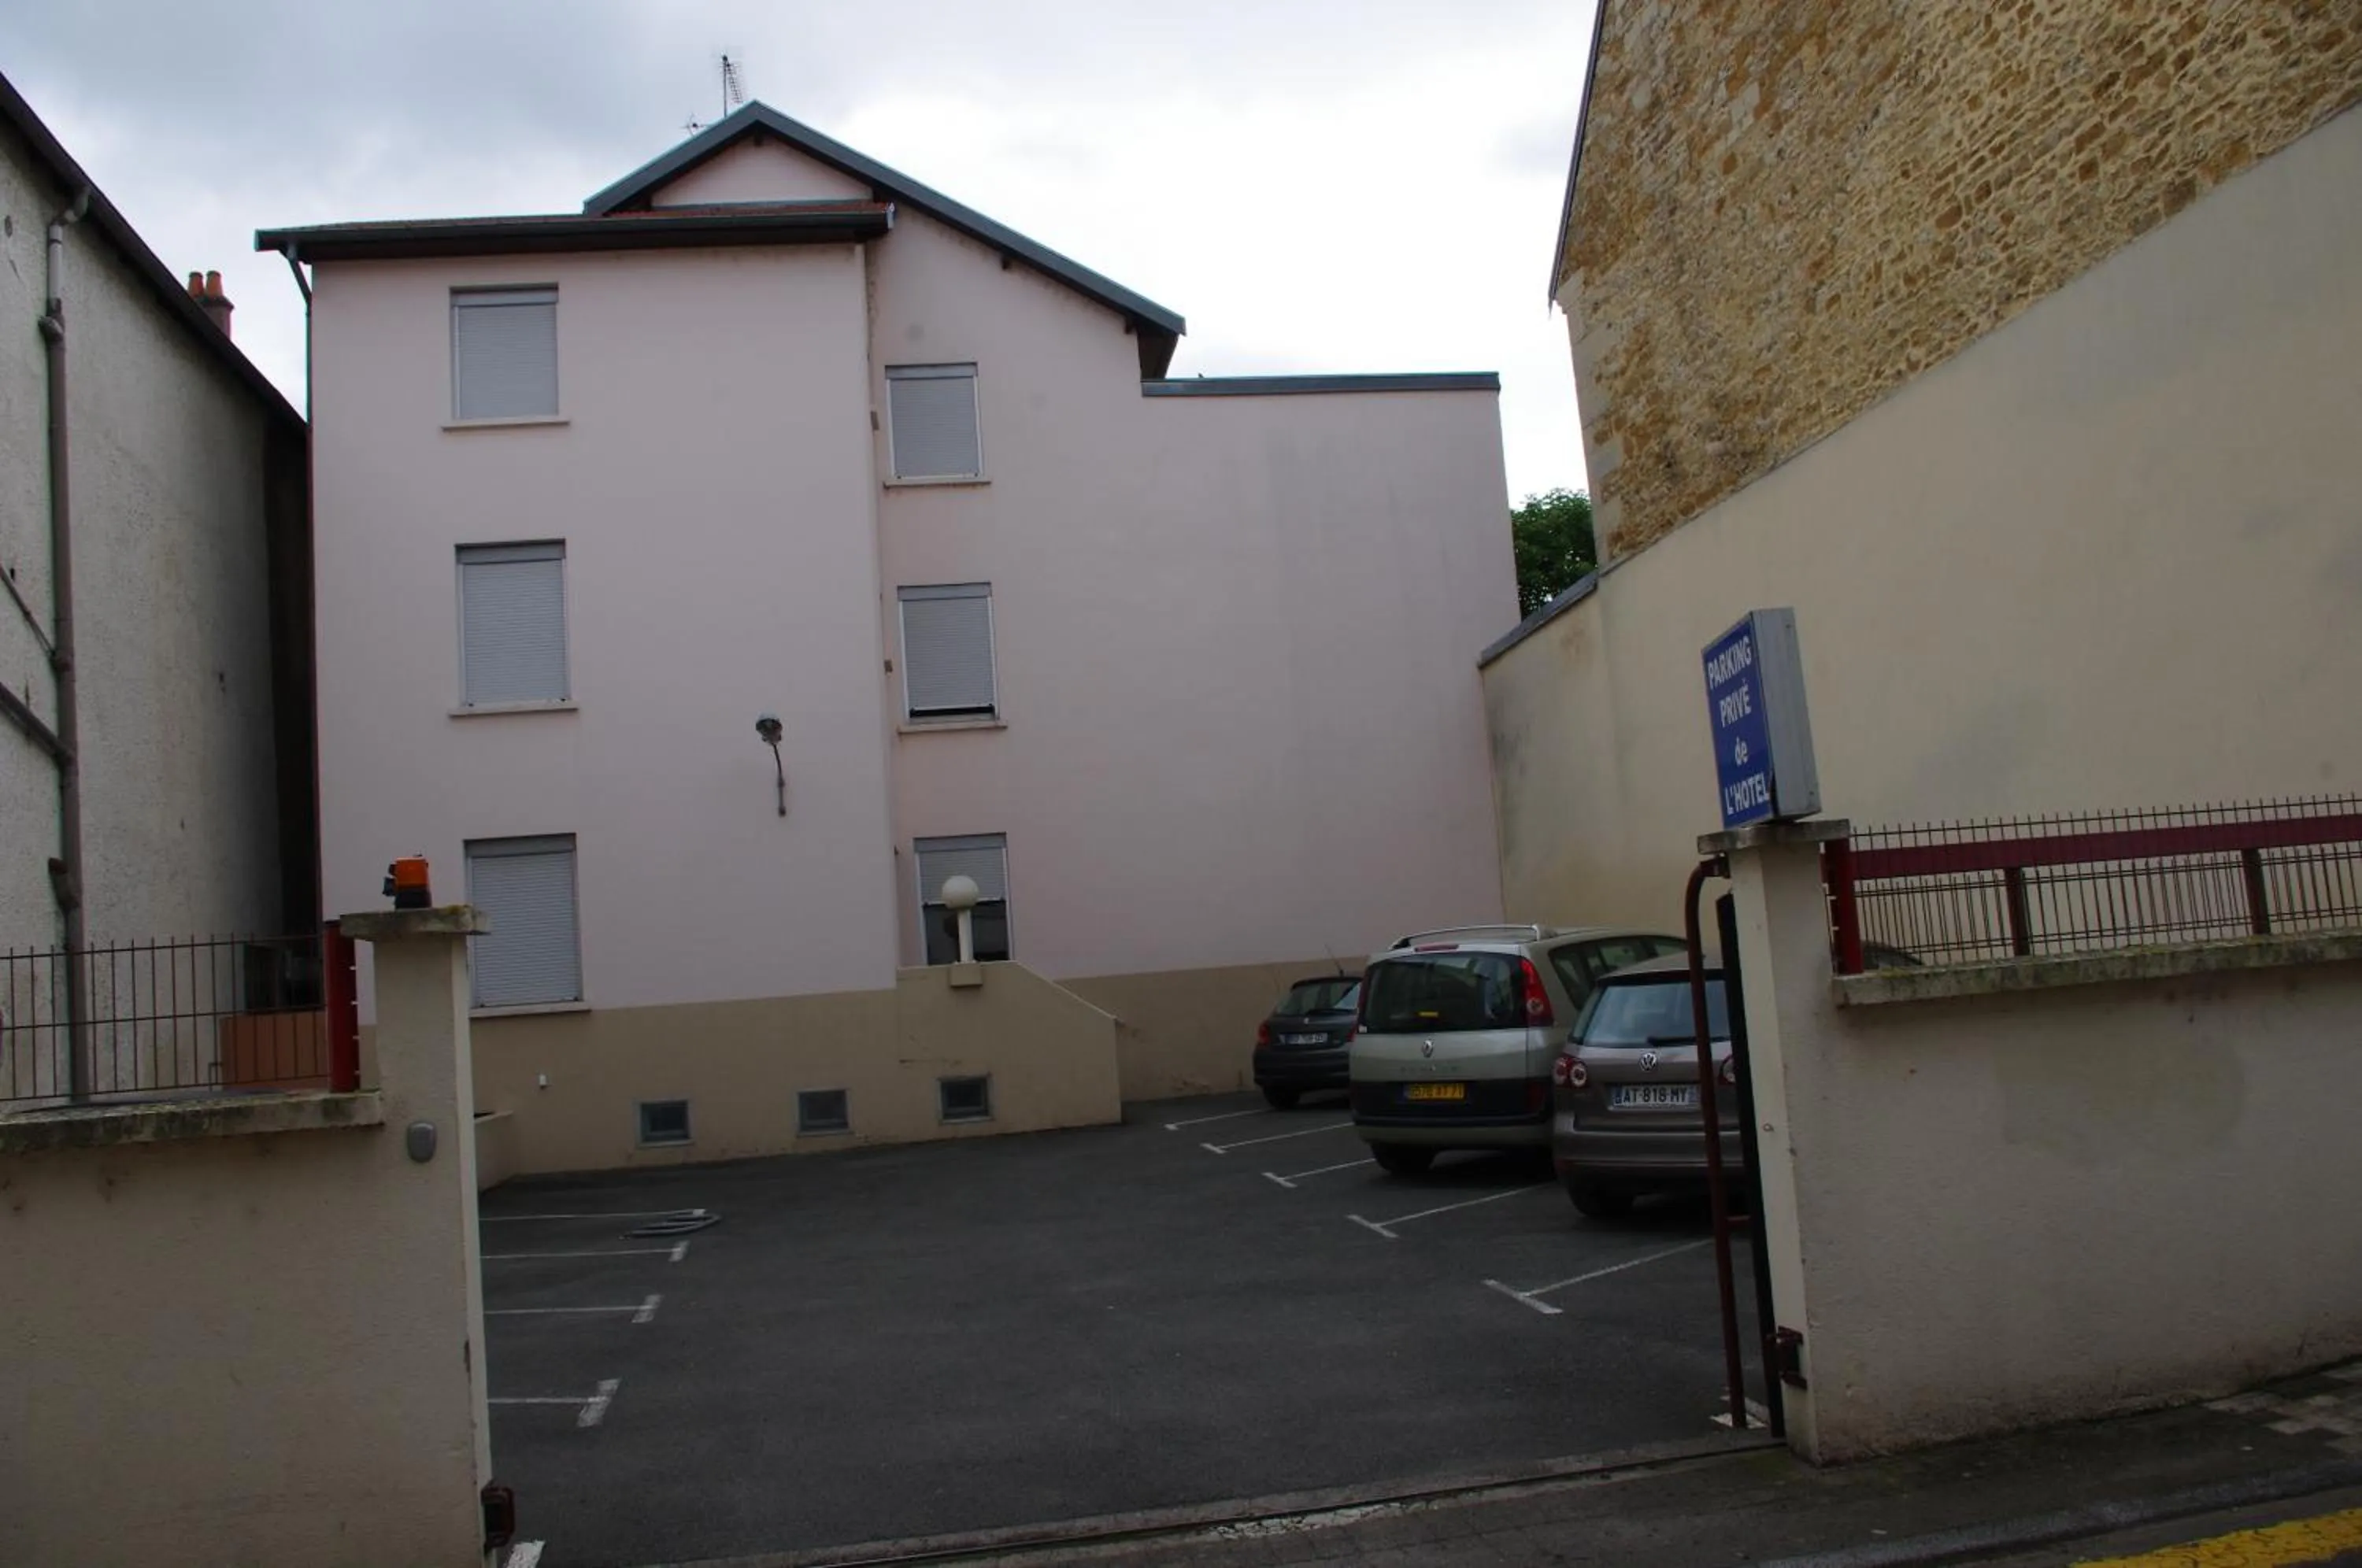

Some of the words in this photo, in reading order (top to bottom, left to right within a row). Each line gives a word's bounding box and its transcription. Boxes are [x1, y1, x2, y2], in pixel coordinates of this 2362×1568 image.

[1708, 635, 1752, 690] PARKING
[1734, 736, 1748, 765] de
[1724, 771, 1770, 815] L'HOTEL
